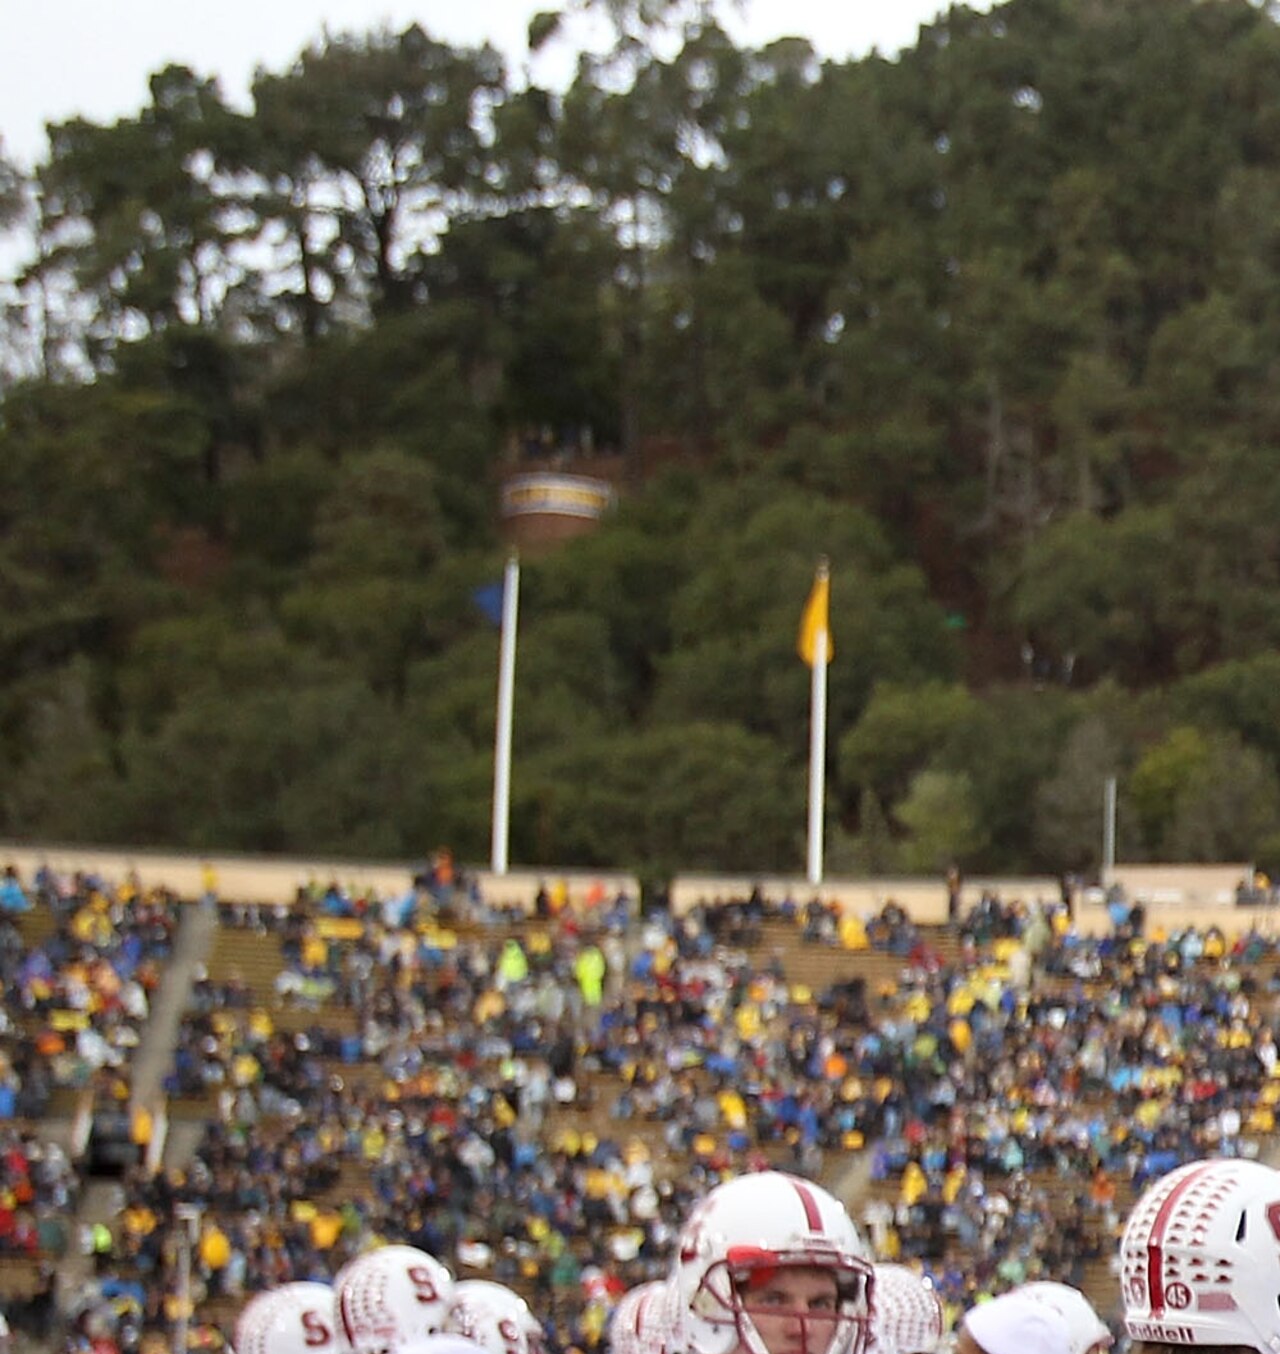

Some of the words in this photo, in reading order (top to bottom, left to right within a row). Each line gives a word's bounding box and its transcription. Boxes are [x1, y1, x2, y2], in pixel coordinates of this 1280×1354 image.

[407, 1265, 438, 1303] S
[1165, 1284, 1189, 1308] 45
[301, 1310, 330, 1347] S
[1127, 1321, 1196, 1344] Riddell
